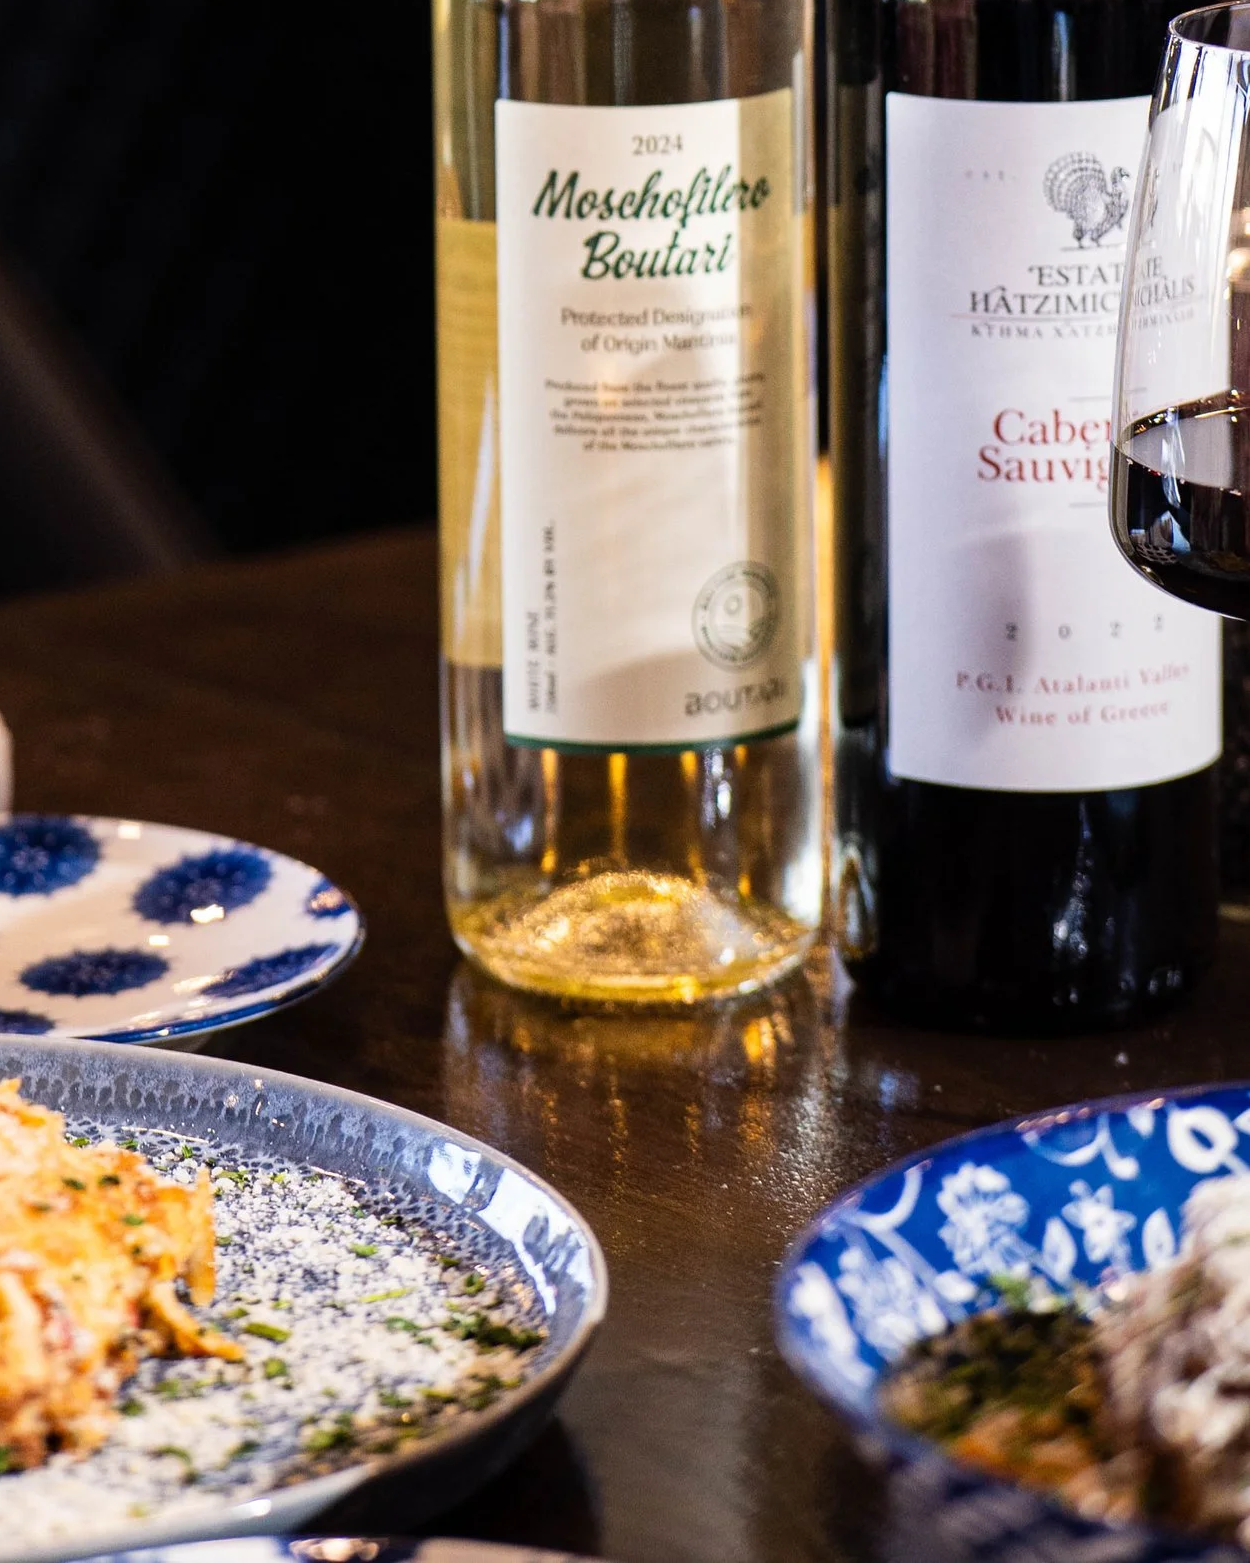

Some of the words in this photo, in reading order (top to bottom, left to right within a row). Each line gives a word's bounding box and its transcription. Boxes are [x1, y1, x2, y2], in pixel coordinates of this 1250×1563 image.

[632, 134, 684, 157] 2024
[531, 163, 771, 229] Moschofilero
[580, 230, 734, 280] Boutari
[561, 307, 649, 327] Protected
[580, 334, 599, 352] of
[603, 334, 658, 356] Origin
[995, 704, 1058, 726] Wine
[1066, 705, 1092, 725] of
[1100, 701, 1169, 724] Greece
